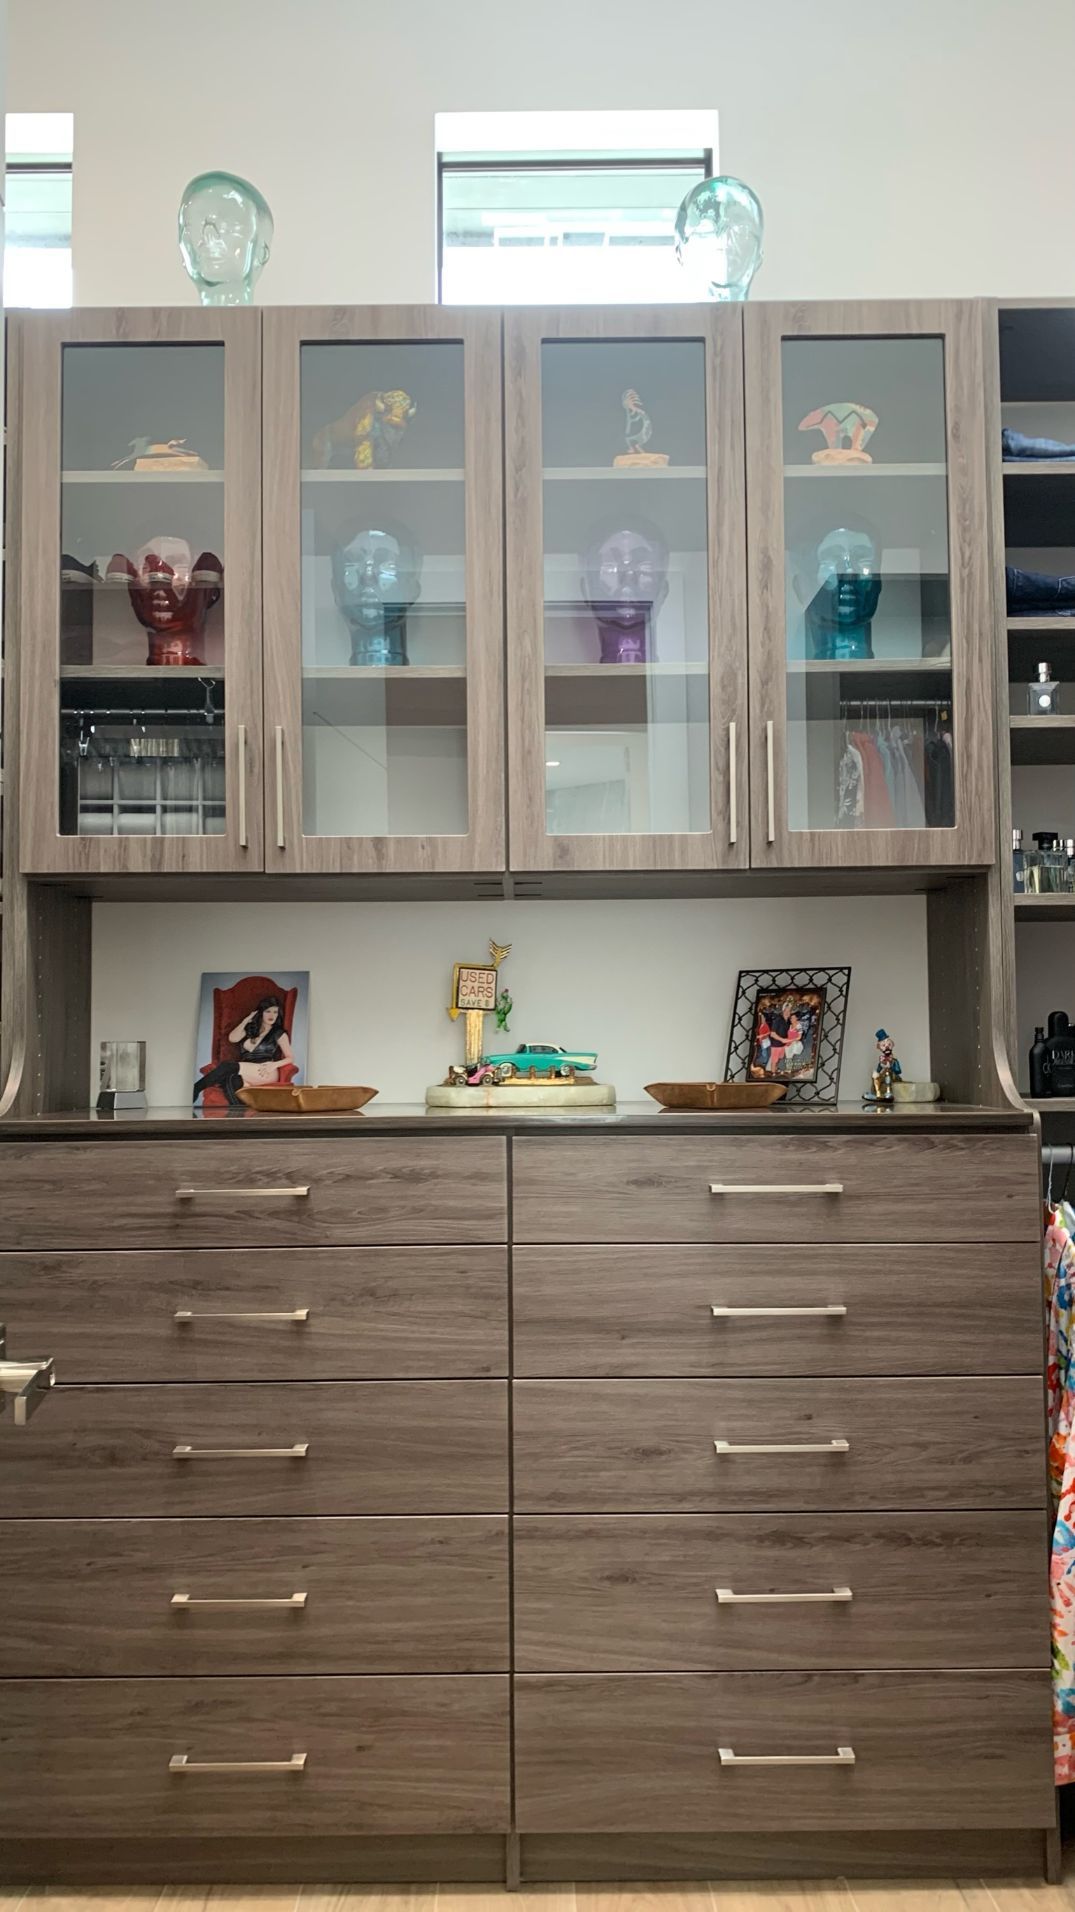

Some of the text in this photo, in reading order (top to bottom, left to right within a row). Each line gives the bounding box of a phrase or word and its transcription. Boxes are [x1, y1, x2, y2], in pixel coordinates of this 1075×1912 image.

[461, 970, 494, 984] USED
[461, 984, 493, 998] CARS
[460, 999, 482, 1007] SAVE
